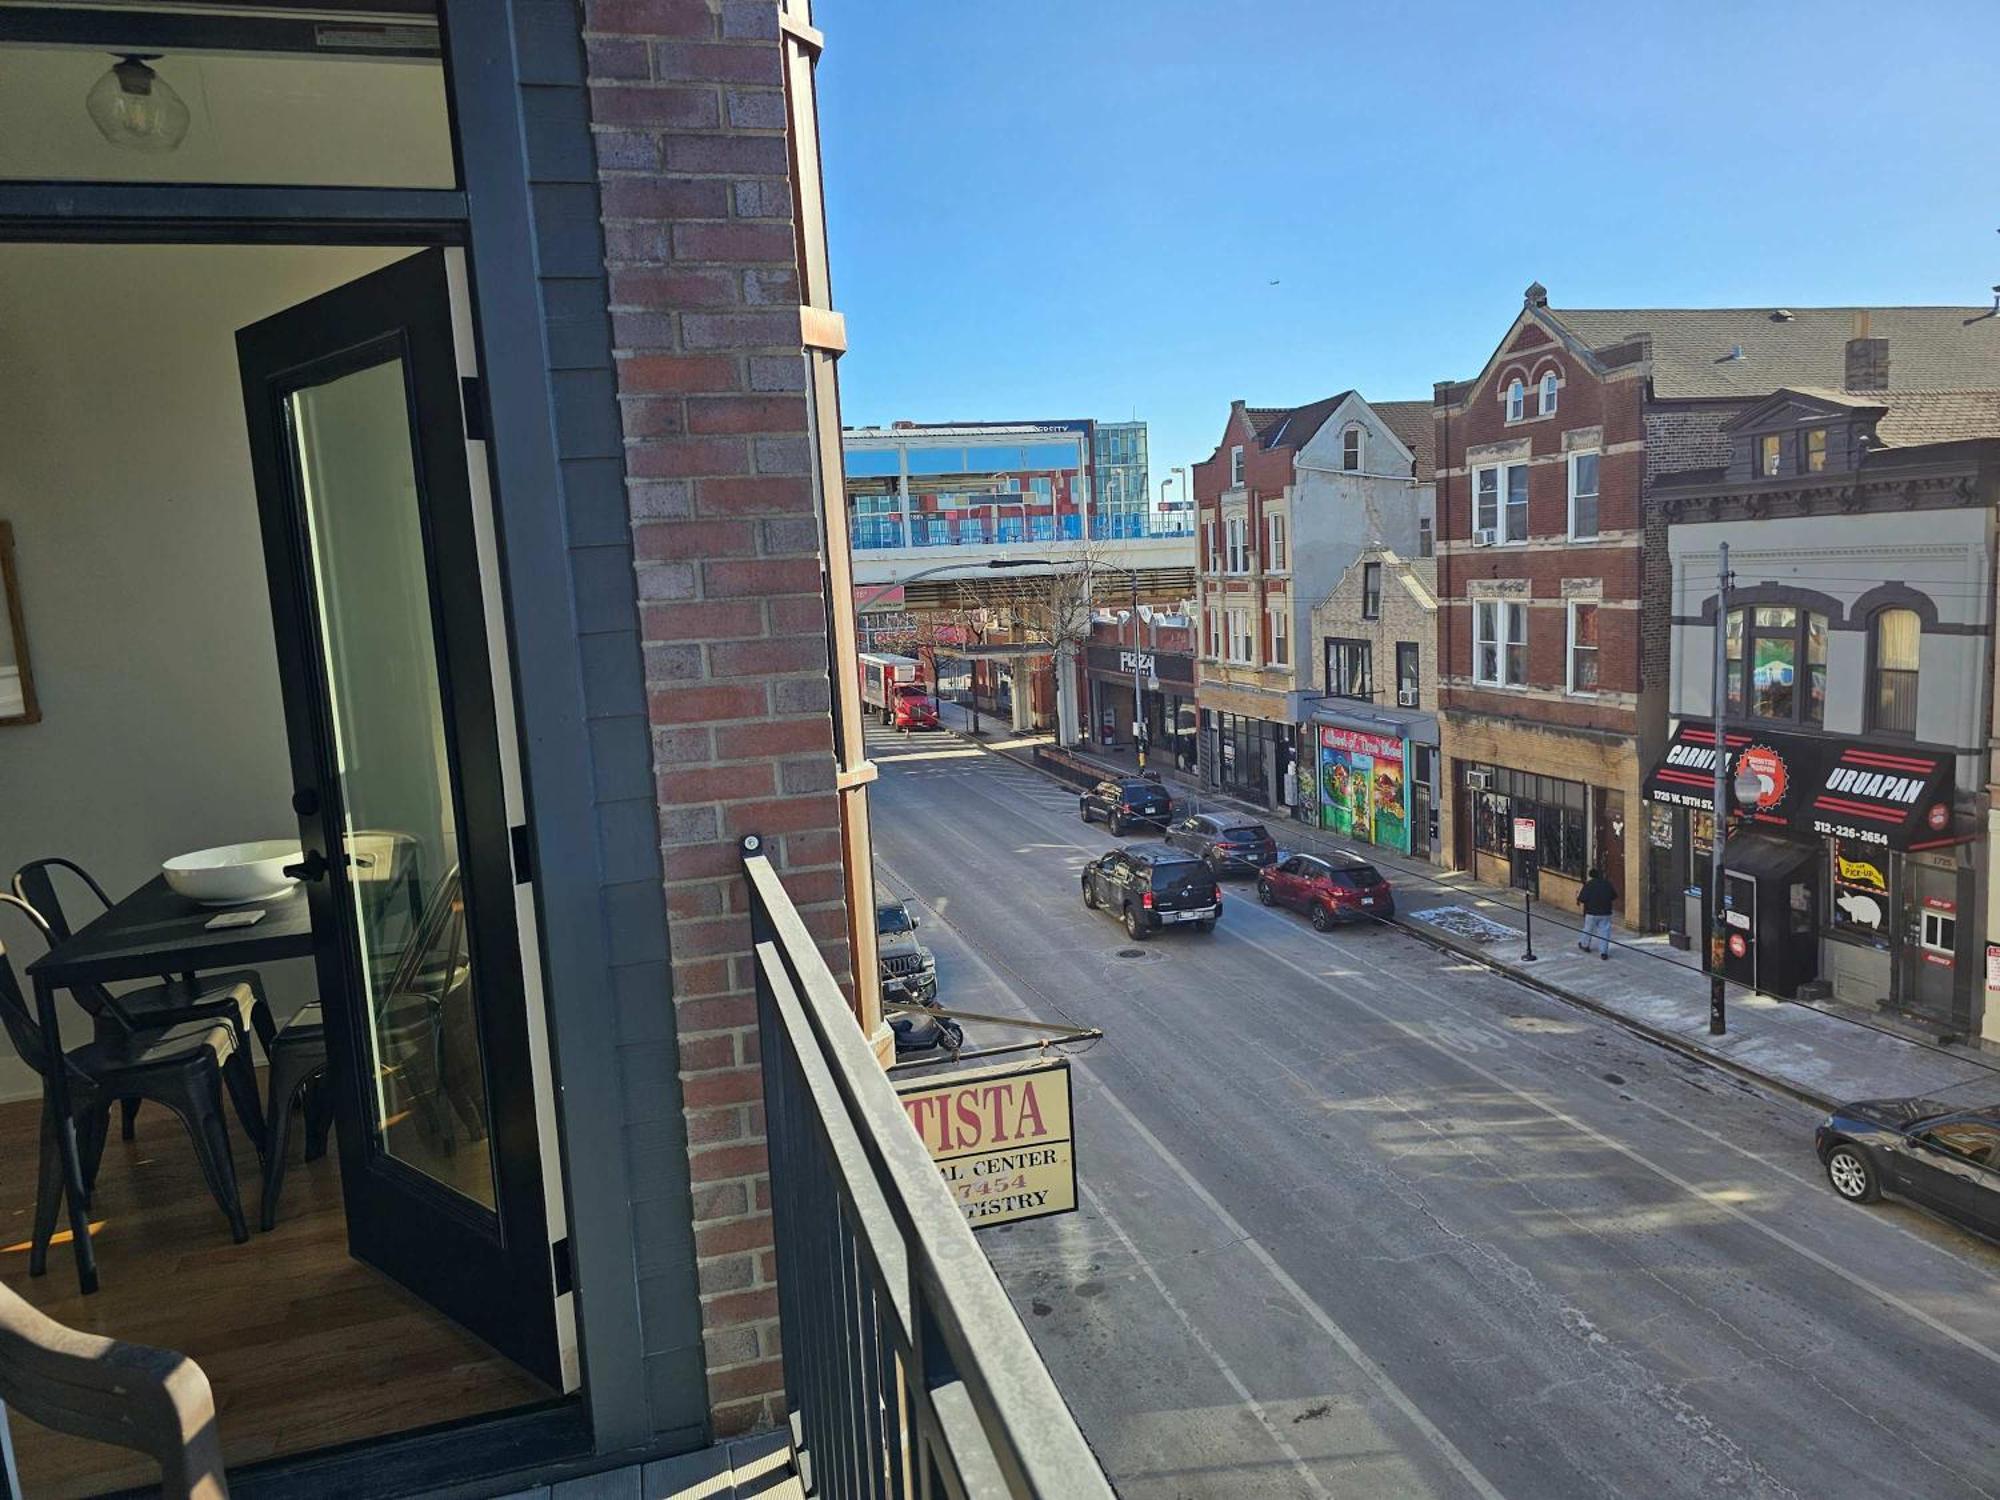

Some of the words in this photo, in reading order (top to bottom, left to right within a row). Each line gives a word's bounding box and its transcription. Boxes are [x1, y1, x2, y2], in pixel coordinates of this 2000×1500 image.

[1825, 767, 1925, 804] URUAPAN
[1814, 820, 1888, 846] 312-226-2654
[973, 1150, 1057, 1177] CENTER
